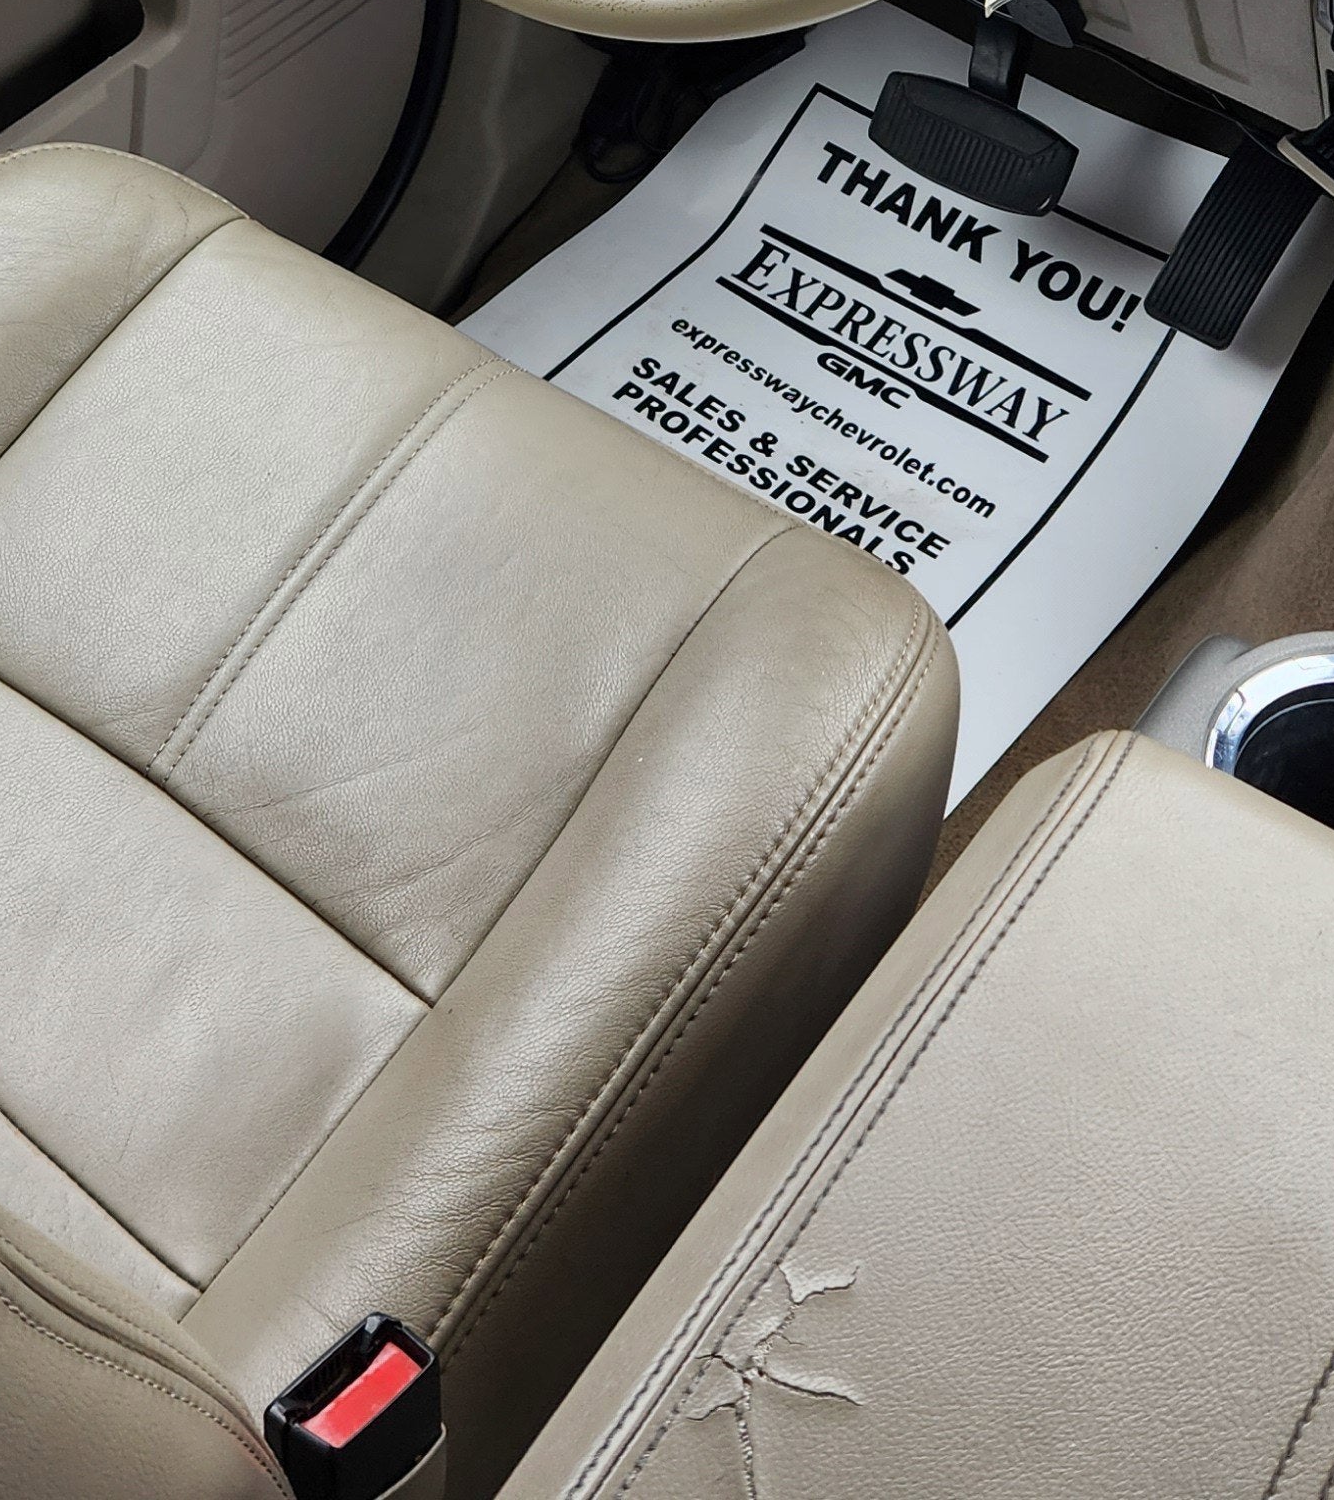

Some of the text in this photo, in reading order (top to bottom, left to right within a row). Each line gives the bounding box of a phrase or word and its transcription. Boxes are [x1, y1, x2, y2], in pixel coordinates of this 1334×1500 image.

[817, 141, 1142, 333] THANK YOU!
[671, 317, 997, 519] expresswaychevrolet.com
[731, 239, 1069, 442] EXPRESSWAY
[817, 352, 910, 409] GMC
[612, 381, 916, 576] PROFESSIONALS
[632, 357, 952, 560] SALES & SERVICE
